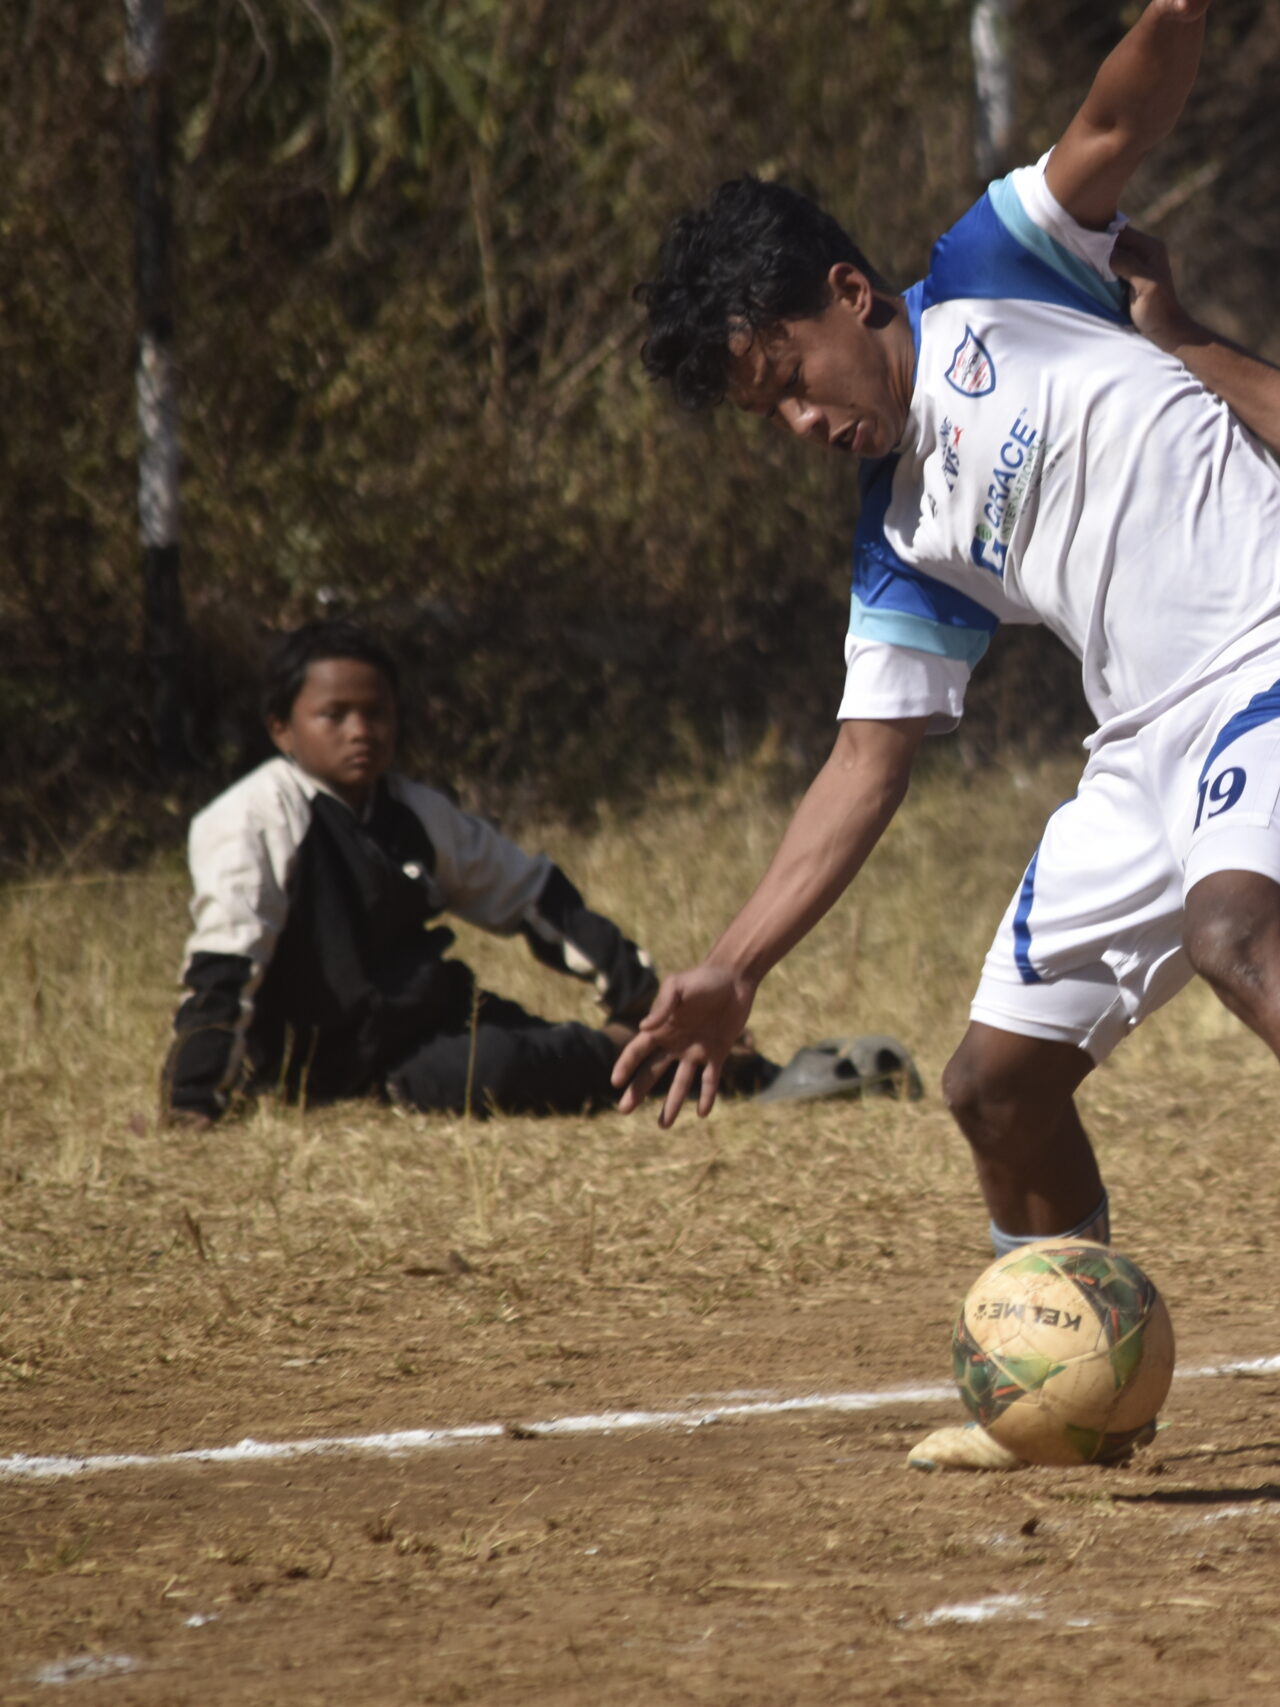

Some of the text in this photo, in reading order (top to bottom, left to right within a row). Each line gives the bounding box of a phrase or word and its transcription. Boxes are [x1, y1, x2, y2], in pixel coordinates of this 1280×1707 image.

[983, 417, 1037, 528] GRACE
[1192, 766, 1247, 835] 19
[987, 1302, 1082, 1332] KELME
